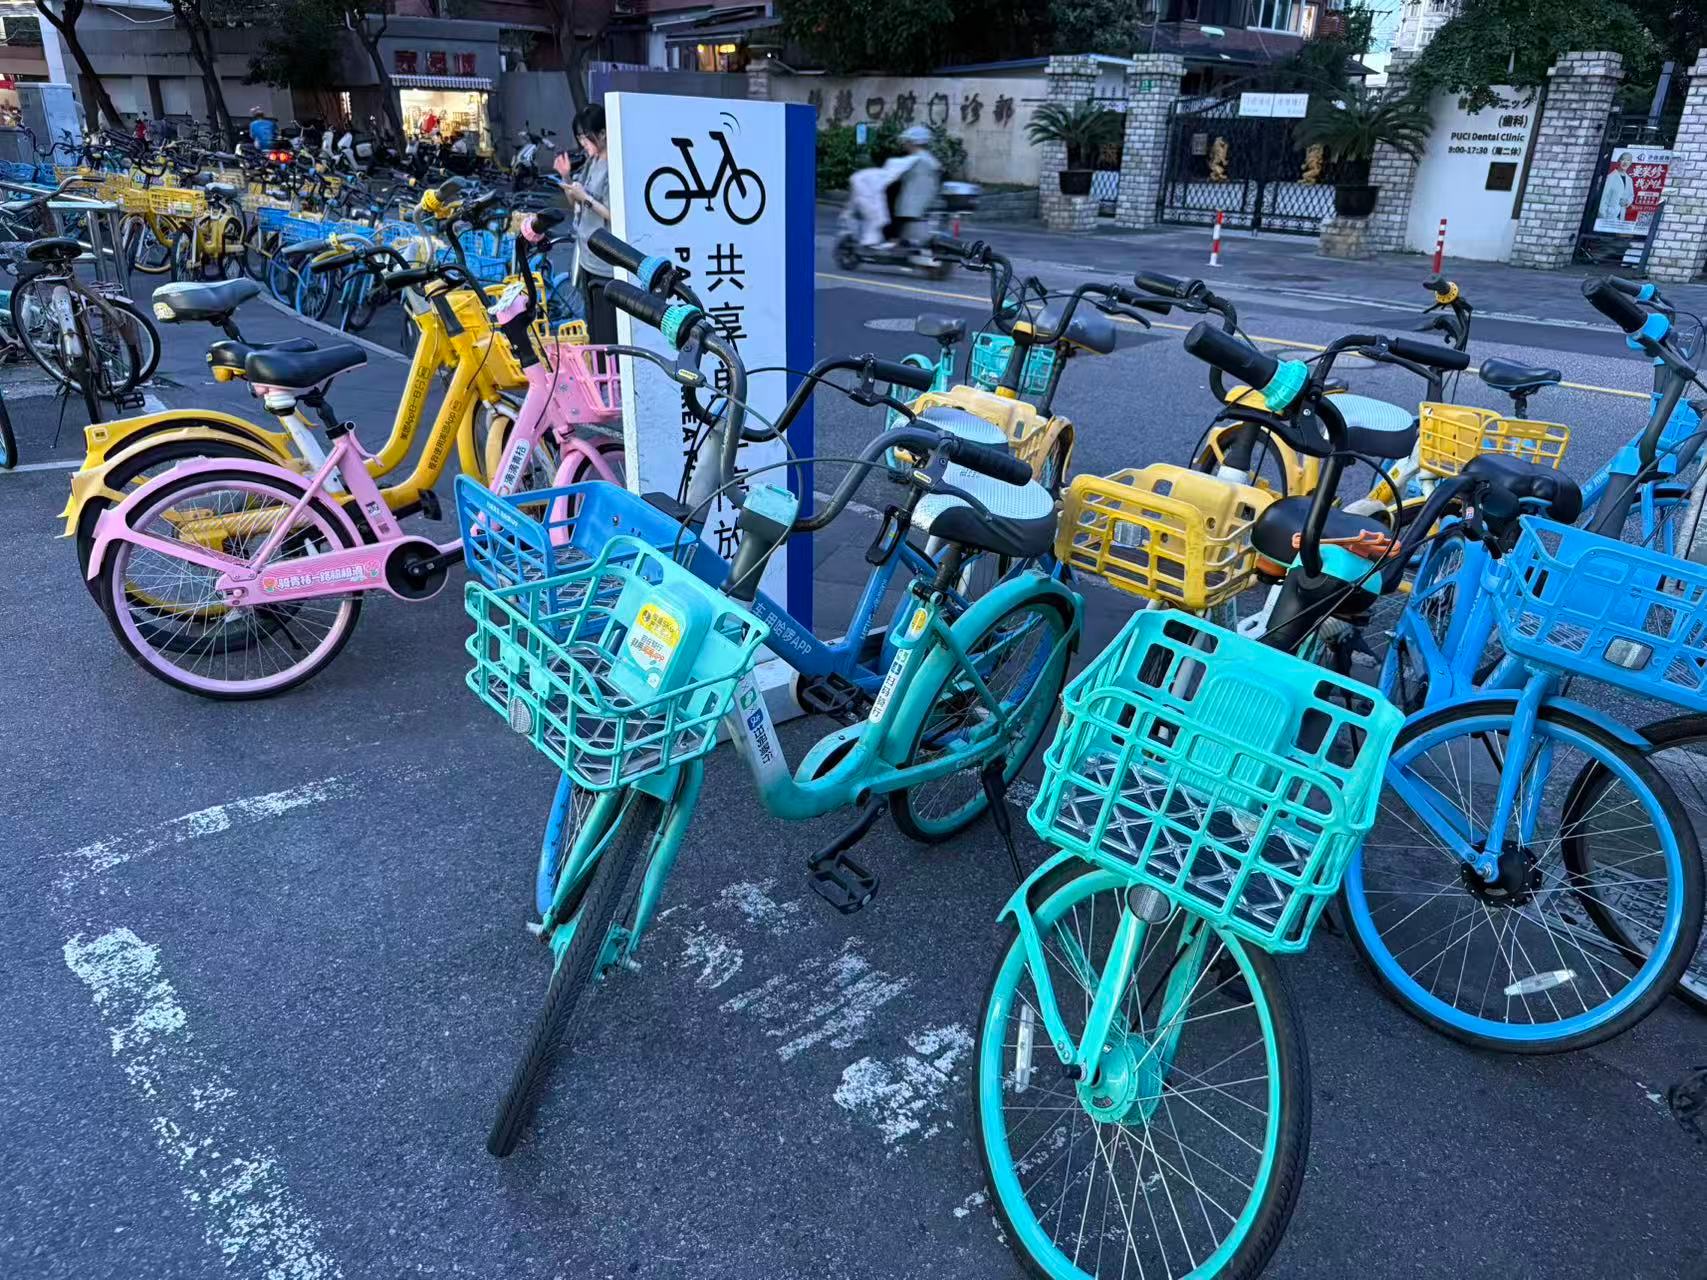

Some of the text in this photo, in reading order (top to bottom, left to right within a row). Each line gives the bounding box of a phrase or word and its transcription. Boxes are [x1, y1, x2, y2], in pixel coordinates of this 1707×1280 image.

[1450, 132, 1525, 142] PUCI Dental Clinic
[504, 446, 527, 486] 滴滴青桔
[764, 612, 813, 655] 用哈啰APP
[753, 724, 773, 765] 扫码骑行
